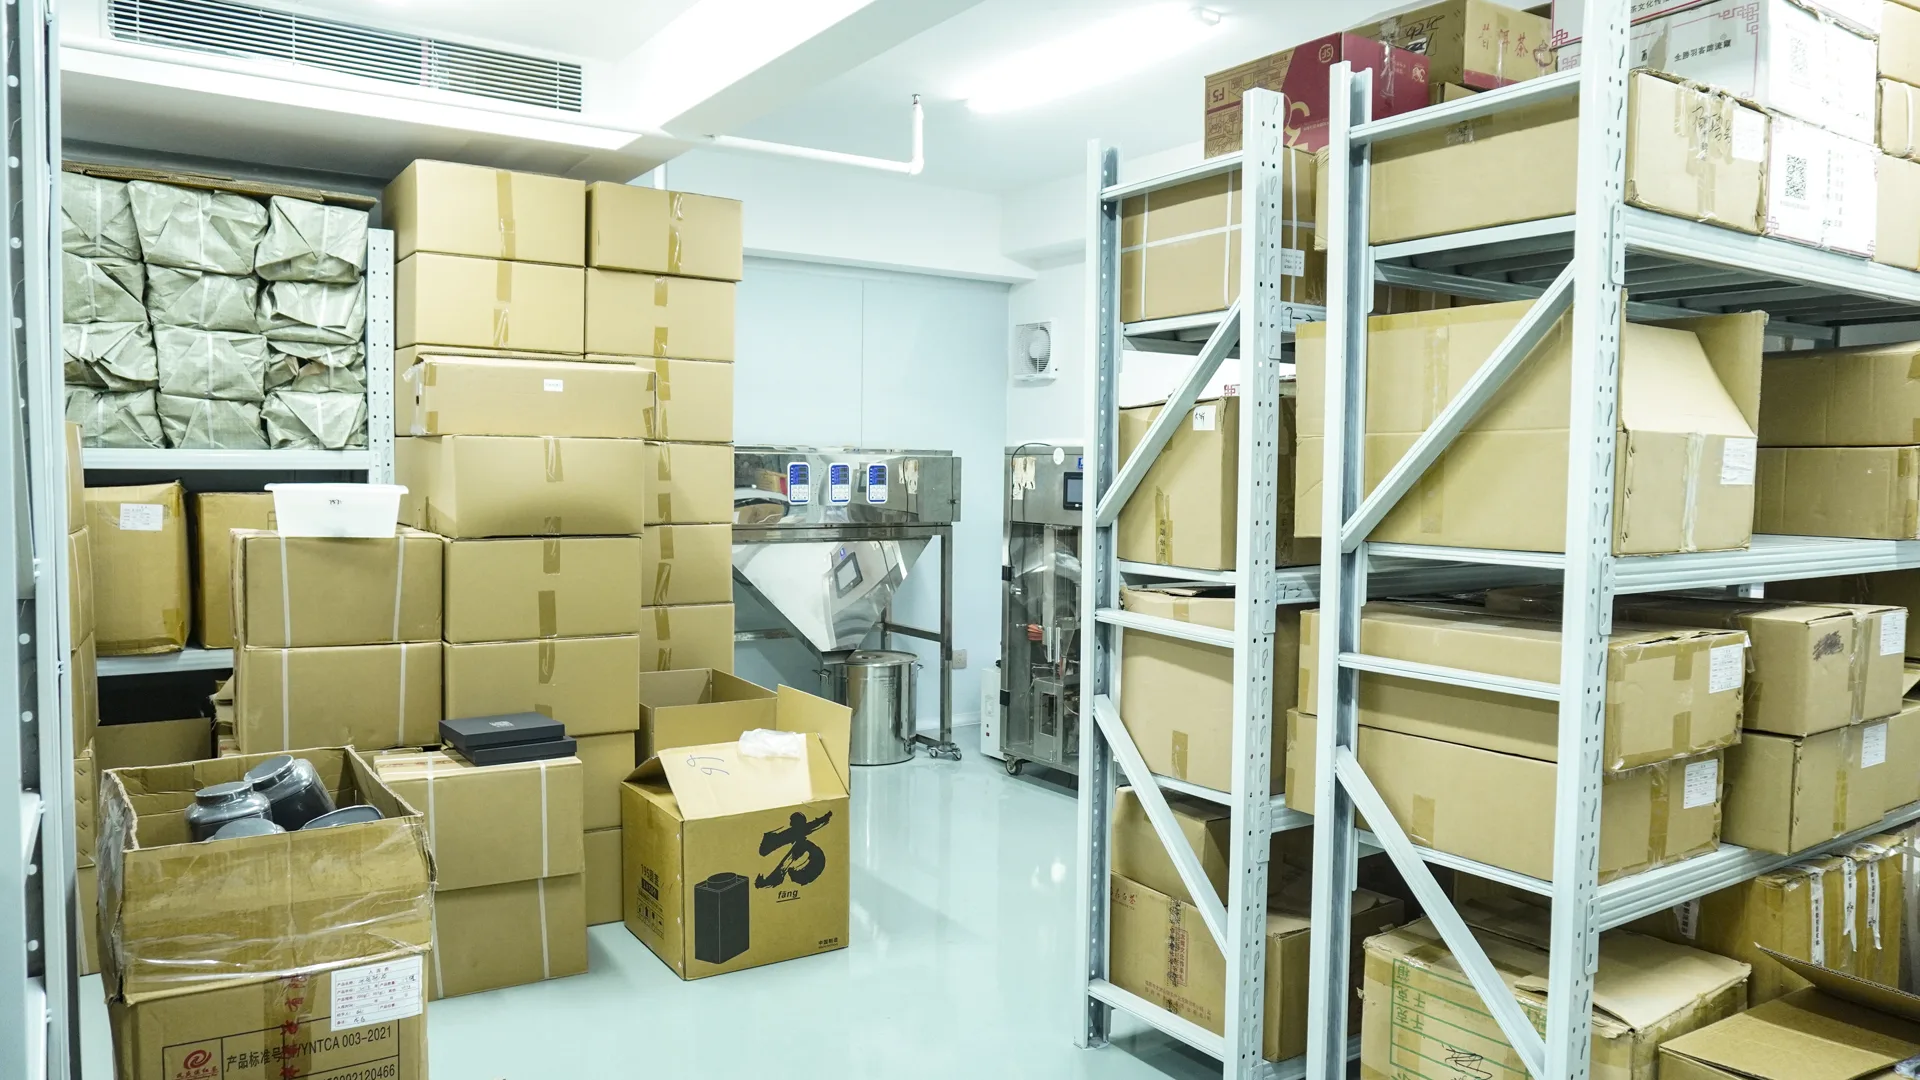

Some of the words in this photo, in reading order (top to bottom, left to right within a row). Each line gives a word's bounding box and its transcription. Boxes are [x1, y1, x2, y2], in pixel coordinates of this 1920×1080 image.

[1212, 86, 1225, 103] F5
[755, 810, 833, 889] 方
[226, 1046, 282, 1073] 产品标准号
[342, 1025, 391, 1047] 003-2021
